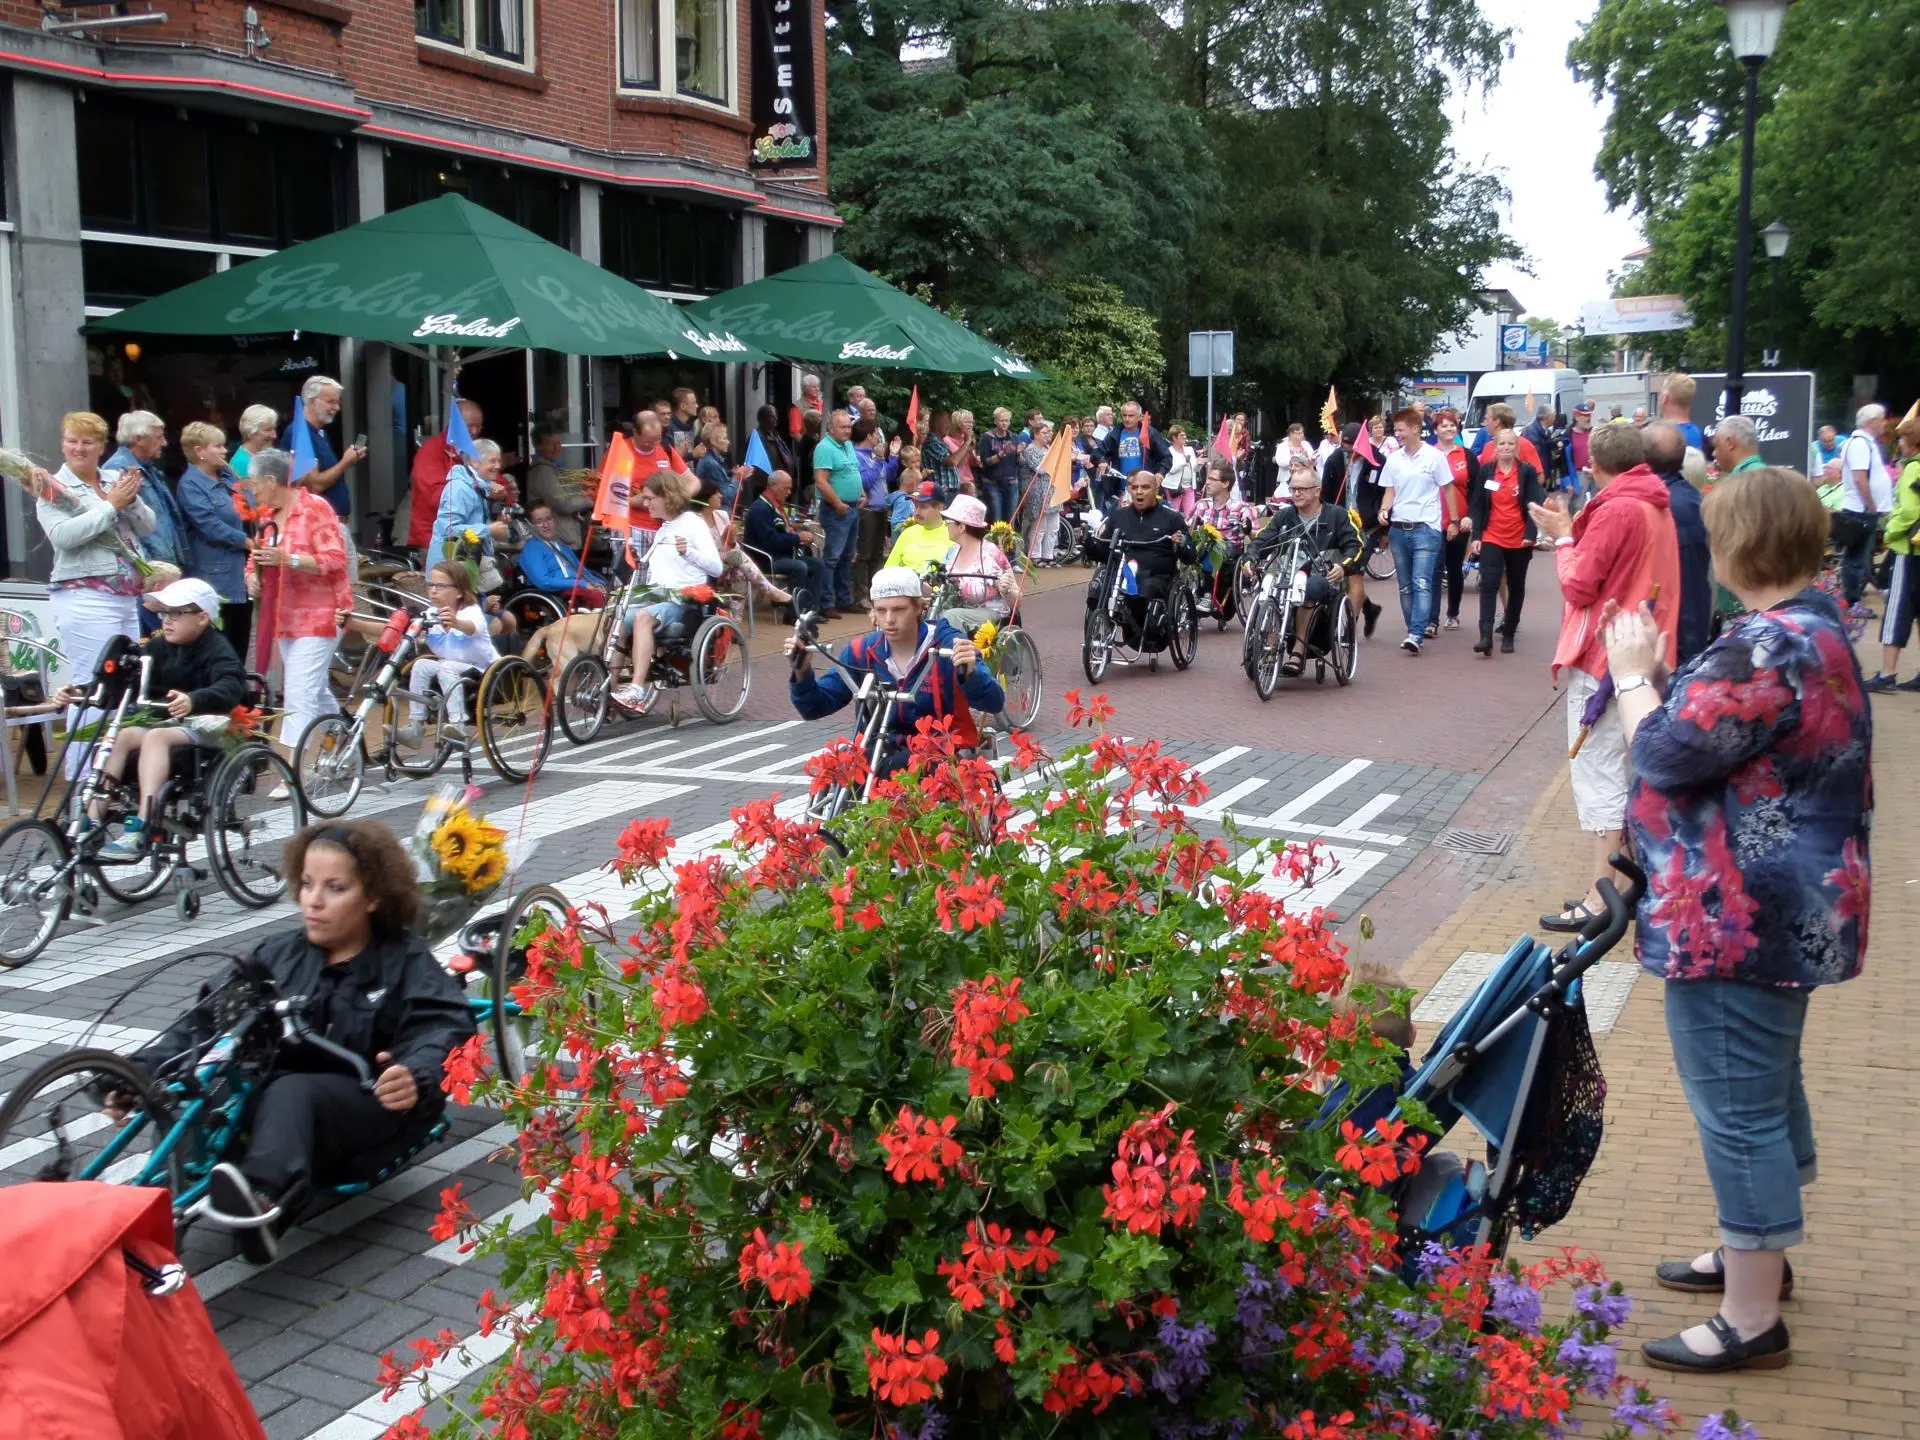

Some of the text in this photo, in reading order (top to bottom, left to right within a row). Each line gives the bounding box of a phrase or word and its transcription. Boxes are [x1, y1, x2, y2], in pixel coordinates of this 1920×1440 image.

[226, 262, 498, 322] Grolsch
[413, 314, 520, 338] Grolsch
[682, 329, 747, 355] Grolsch
[838, 342, 914, 360] Grolsch
